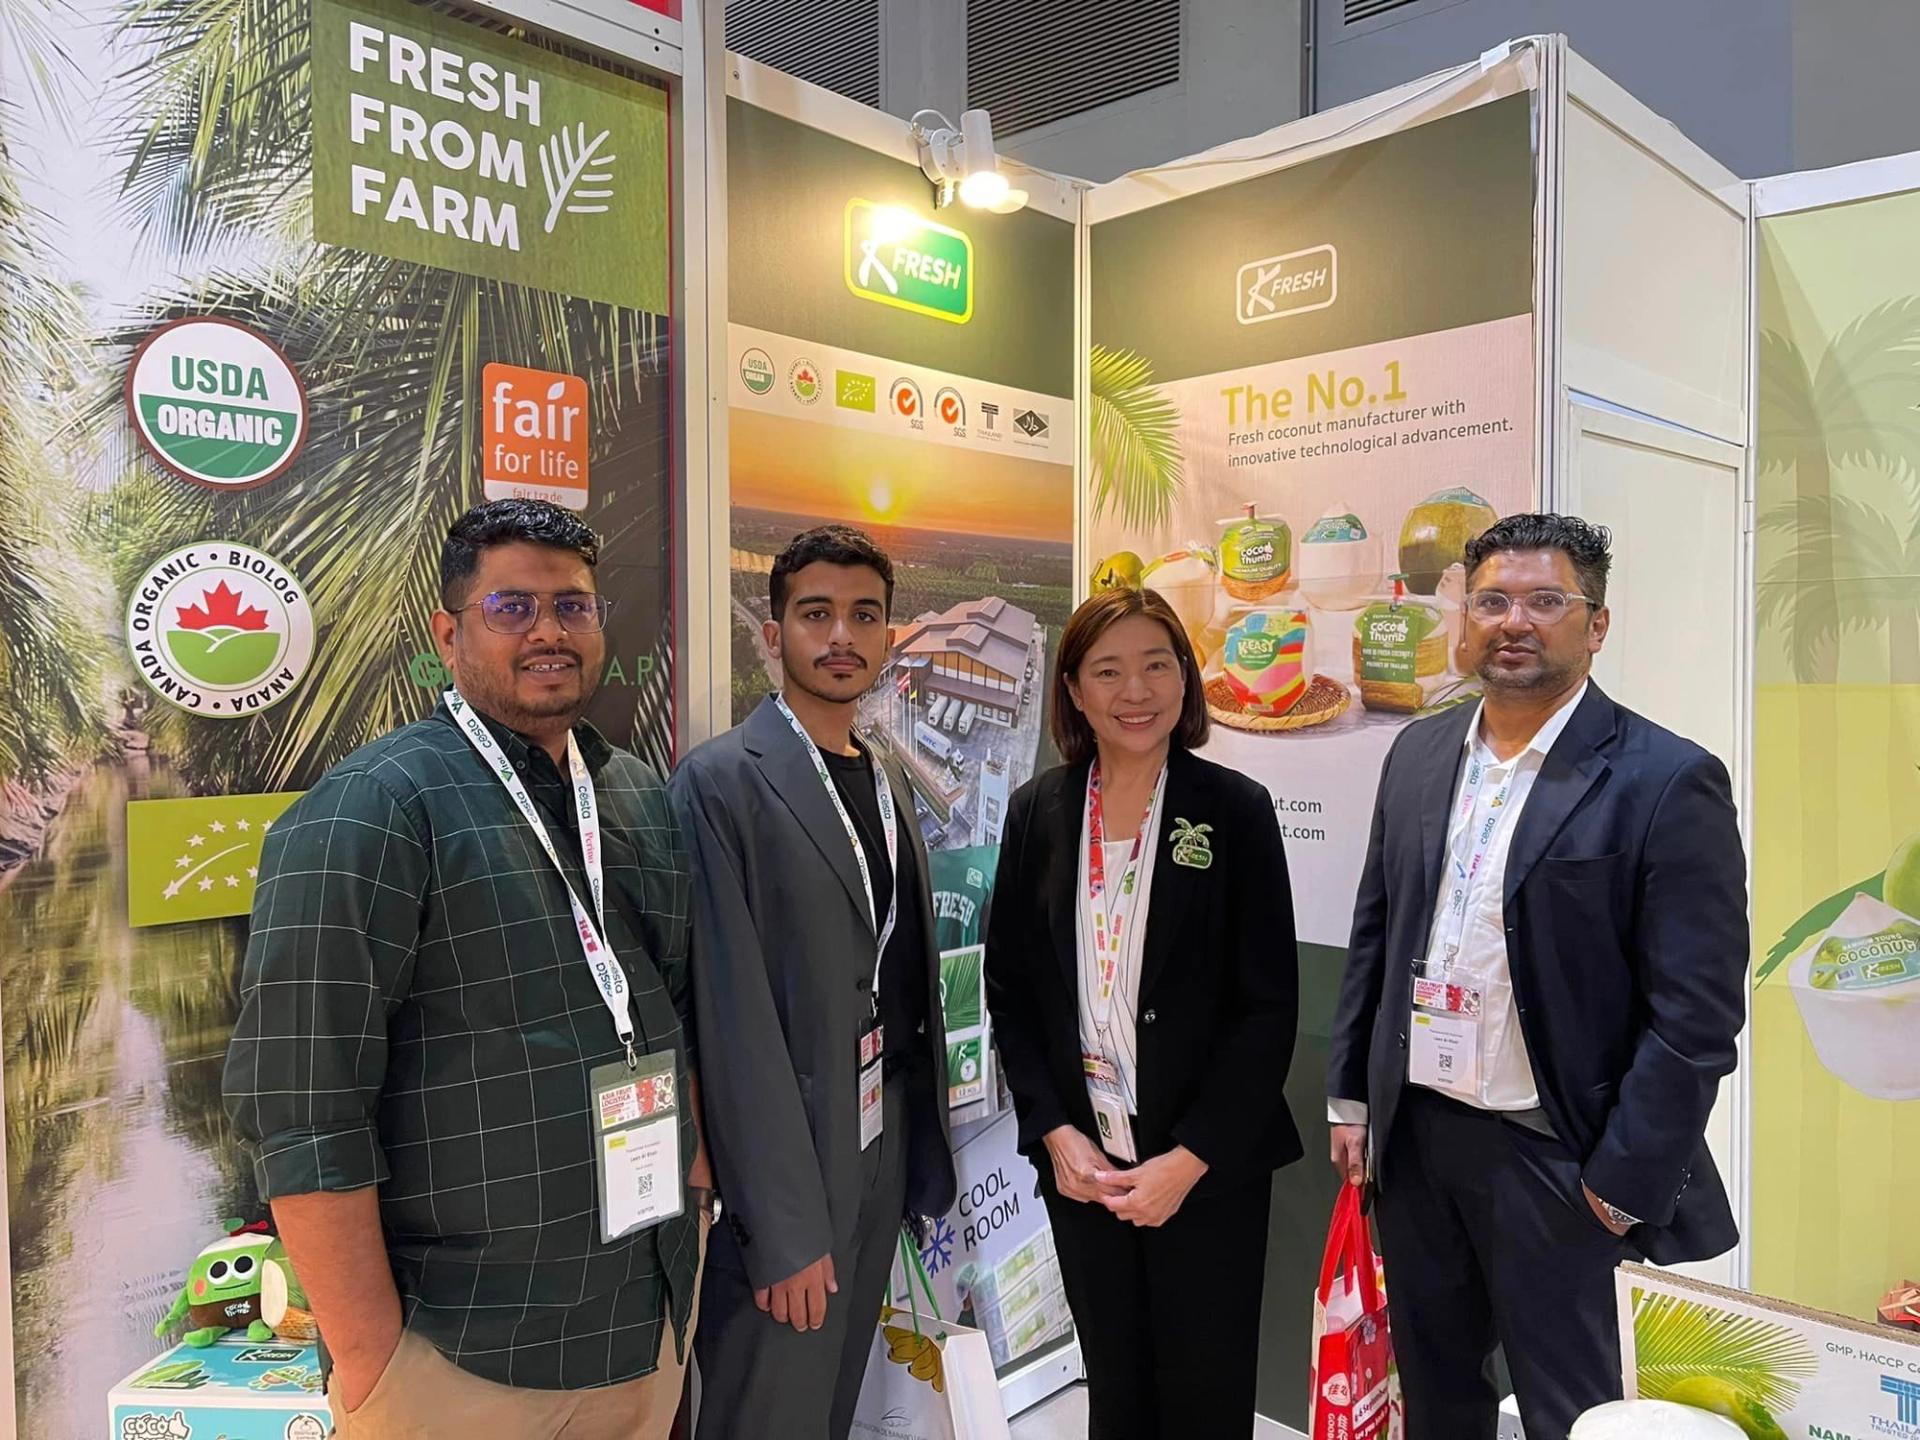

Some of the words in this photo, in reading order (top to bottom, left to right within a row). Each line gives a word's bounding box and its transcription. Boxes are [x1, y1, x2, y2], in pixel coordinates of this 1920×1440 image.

[350, 21, 541, 127] FRESH
[350, 93, 527, 188] FROM
[351, 164, 520, 251] FARM
[892, 247, 962, 290] FRESH
[1271, 268, 1327, 298] FRESH
[171, 355, 269, 401] USDA
[748, 358, 767, 371] USDA
[492, 381, 580, 442] fair
[1220, 384, 1292, 426] The
[1307, 360, 1407, 414] No.1
[157, 403, 283, 447] ORGANIC
[910, 419, 924, 431] SGS
[953, 426, 967, 438] SGS
[1228, 431, 1264, 446] Fresh
[1267, 422, 1322, 440] coconut
[1326, 406, 1428, 431] manufacturer
[1431, 399, 1466, 416] with
[1228, 448, 1297, 468] innovative
[1299, 431, 1397, 458] technological
[1401, 418, 1514, 445] advancement.
[494, 444, 532, 474] for
[540, 449, 579, 479] life
[513, 487, 531, 499] fair
[534, 489, 563, 503] trade
[132, 552, 201, 632] ORGANIC
[228, 550, 299, 605] BIOLOG
[135, 639, 202, 709] CANADA
[1837, 939, 1916, 966] coconut
[602, 1095, 631, 1107] LOGISTICA
[958, 1167, 1011, 1218] COOL
[963, 1192, 1020, 1252] ROOM
[1825, 1342, 1857, 1359] GMP,
[1860, 1350, 1904, 1369] HACCP
